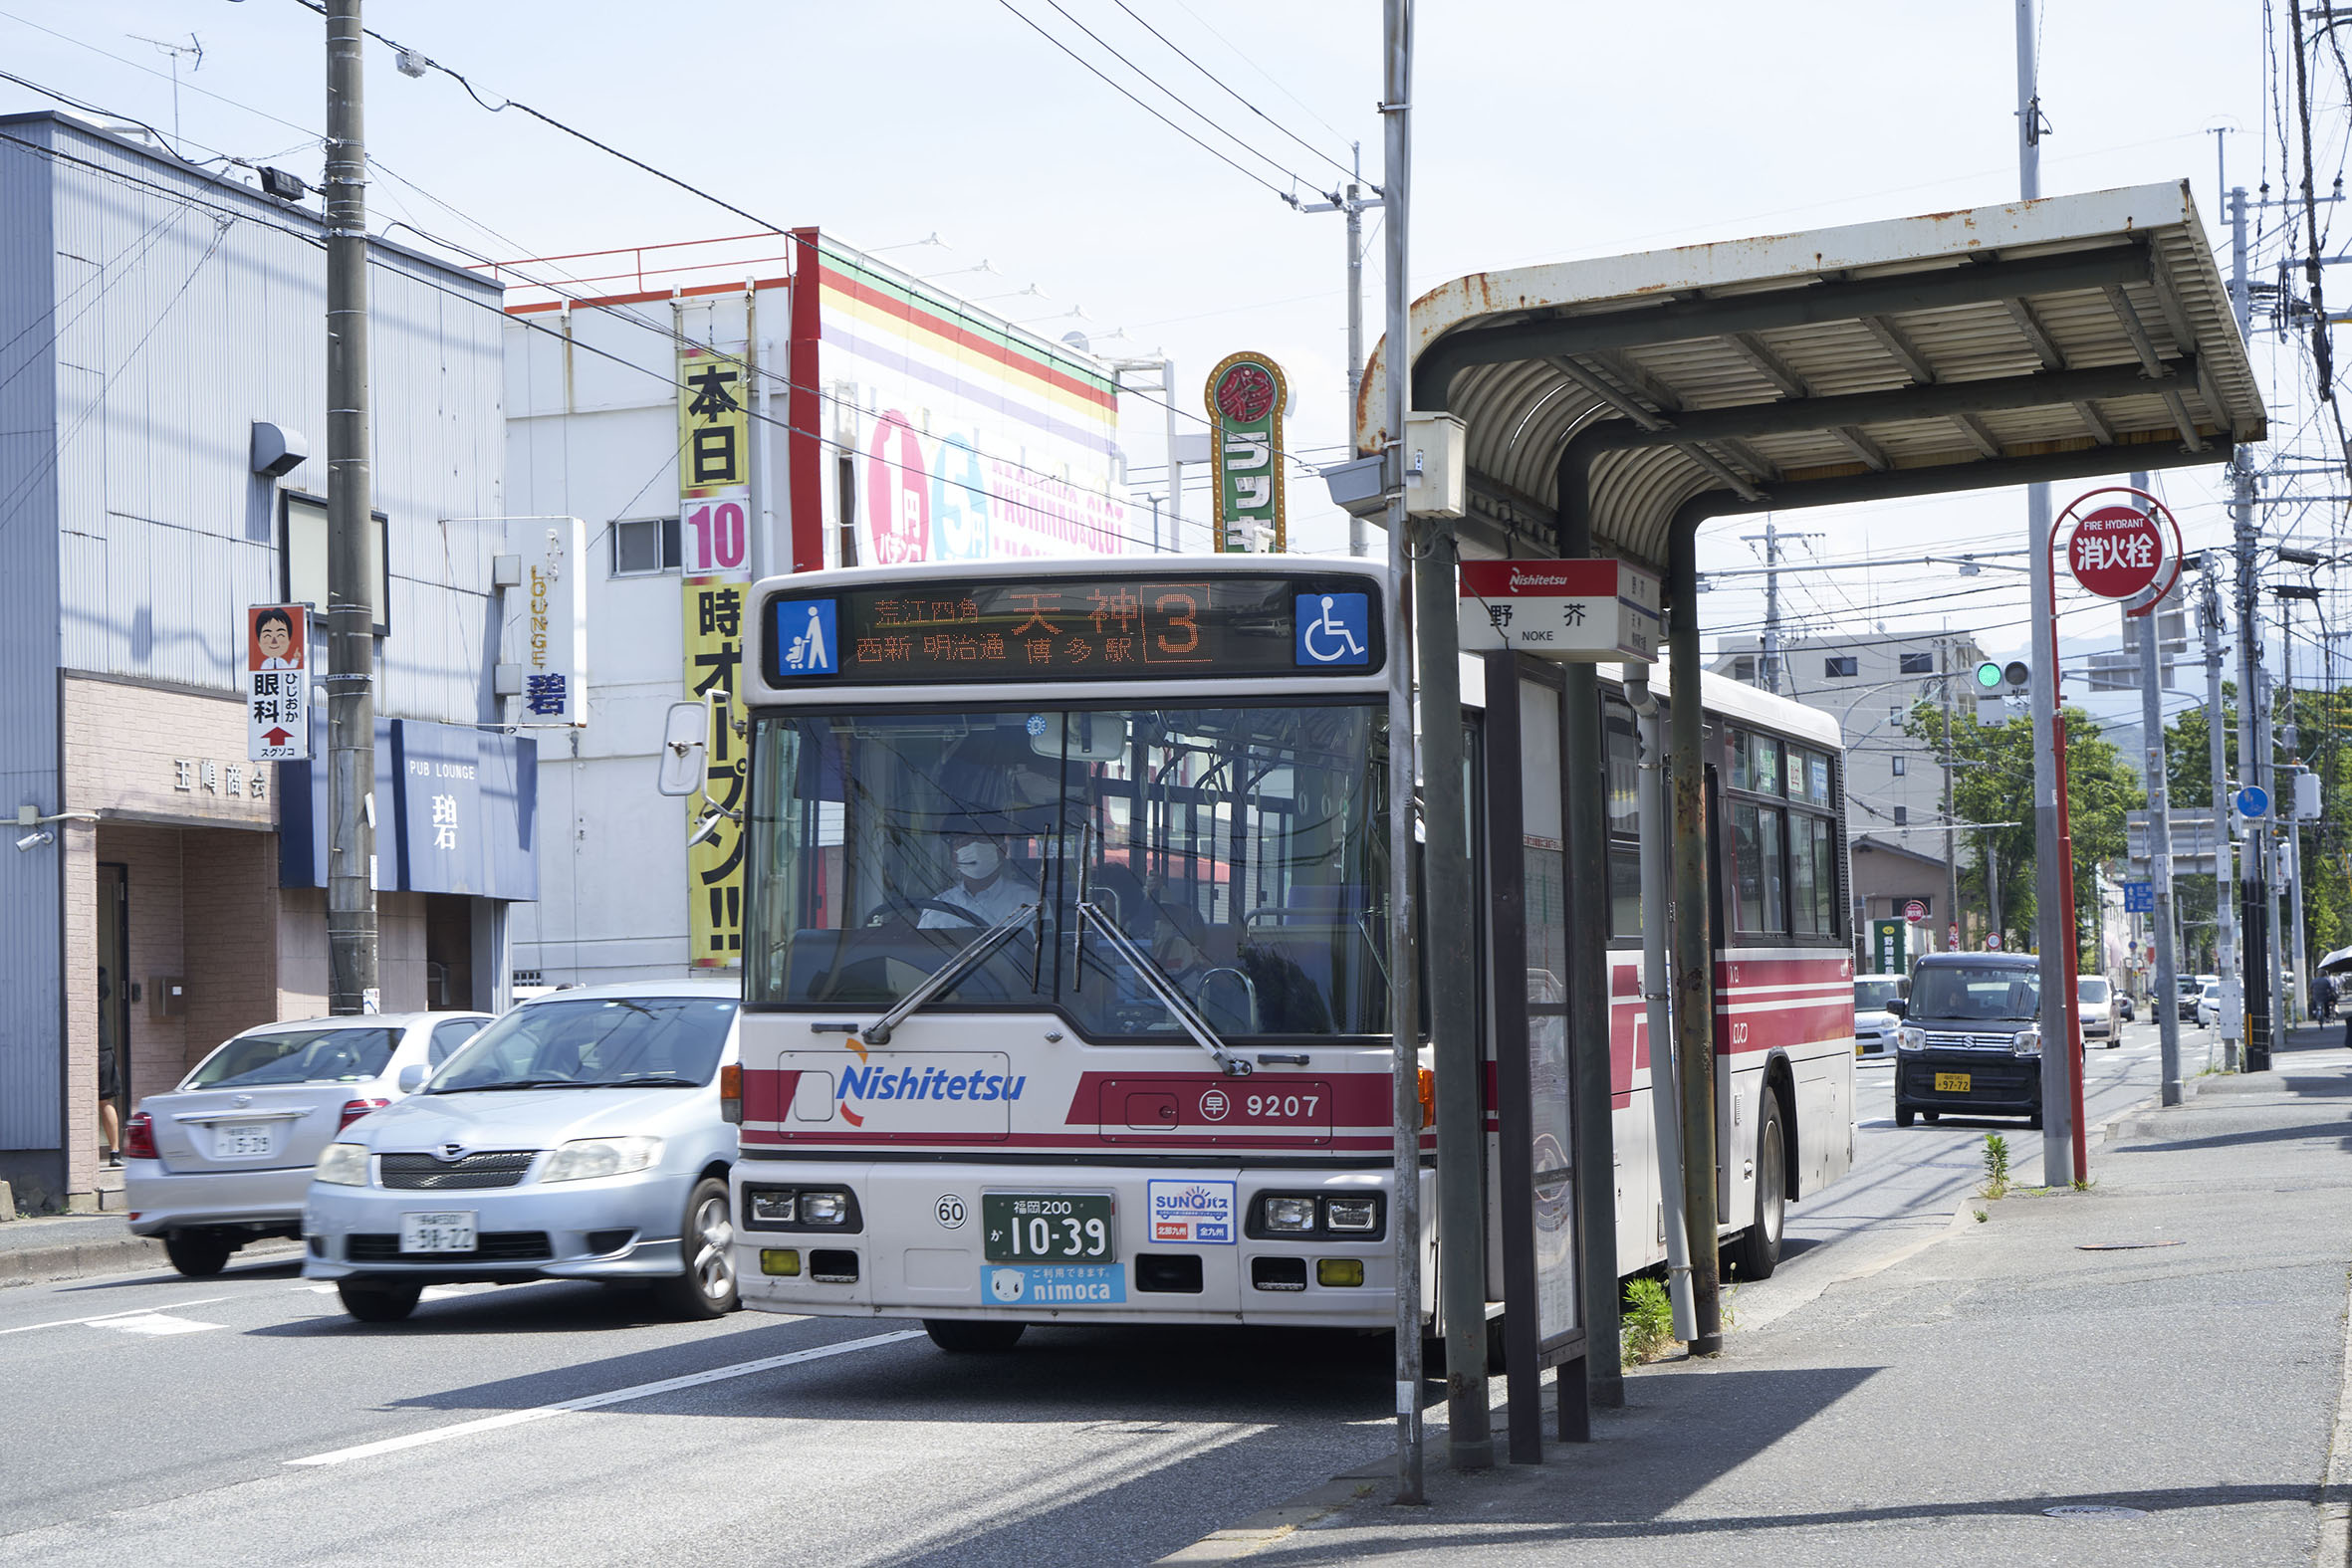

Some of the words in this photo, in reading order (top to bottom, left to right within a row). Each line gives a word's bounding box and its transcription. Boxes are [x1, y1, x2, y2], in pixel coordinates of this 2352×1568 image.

[688, 365, 739, 483] 本日
[688, 502, 745, 569] 10
[2084, 520, 2103, 531] FIRE
[2105, 518, 2145, 531] HYDRANT
[2076, 534, 2155, 570] 消火栓
[1509, 574, 1568, 586] Nishitetsu
[531, 564, 548, 667] LOUNGE
[875, 597, 979, 625] 荒江四角
[1009, 586, 1139, 635] 天神
[1154, 592, 1199, 653] 3
[1490, 603, 1586, 627] 野芥
[856, 635, 914, 663] 西新
[923, 632, 1007, 661] 明治通
[1024, 637, 1135, 665] 博多駅
[1522, 630, 1554, 642] NOKE
[254, 673, 280, 724] 眼科
[285, 673, 299, 723] ひじおか
[261, 748, 295, 757] スグソコ
[409, 760, 430, 776] PUB
[435, 763, 476, 781] LOUNGE
[431, 794, 458, 850] 碧
[835, 1065, 1028, 1101] Nishitetsu
[1205, 1096, 1224, 1115] 早
[1247, 1095, 1319, 1117] 9207
[938, 1202, 965, 1222] 60
[1014, 1201, 1072, 1215] 福岡200
[991, 1230, 1003, 1241] か
[1012, 1218, 1107, 1256] 10-39
[1033, 1267, 1110, 1279] ご利用できます。
[1034, 1279, 1110, 1300] nimoca
